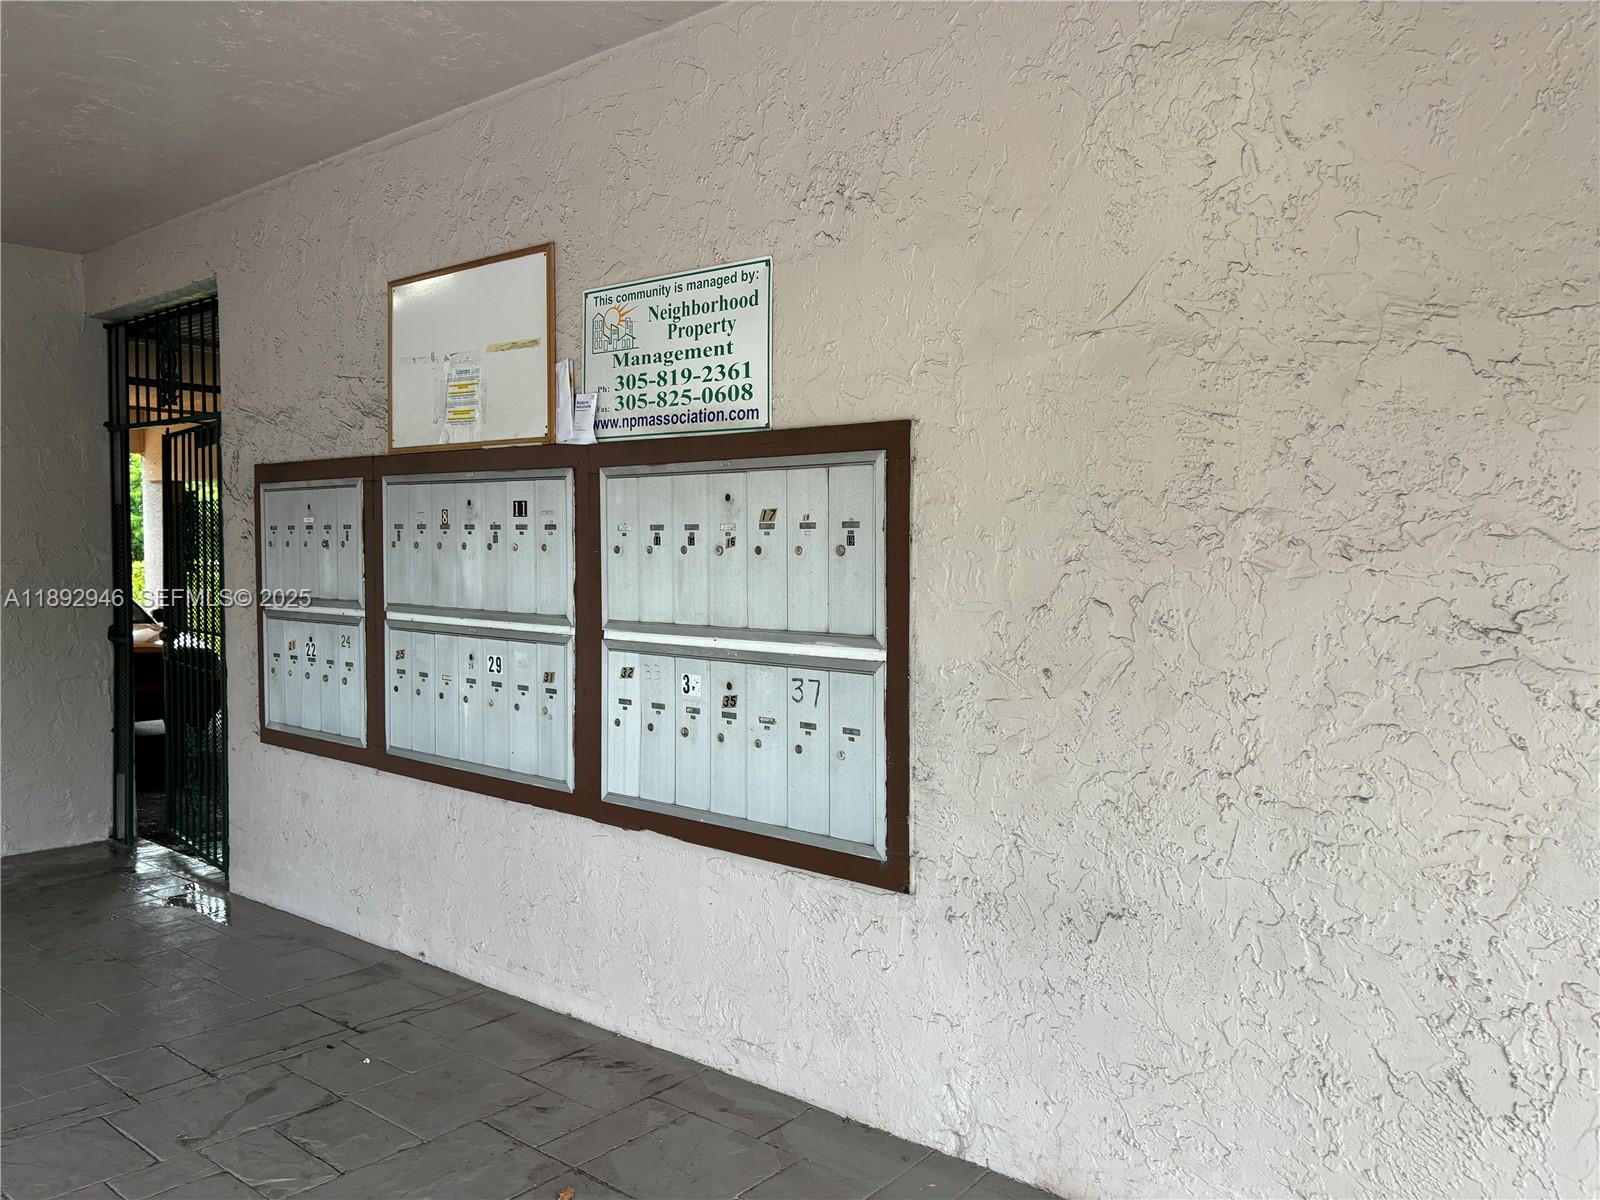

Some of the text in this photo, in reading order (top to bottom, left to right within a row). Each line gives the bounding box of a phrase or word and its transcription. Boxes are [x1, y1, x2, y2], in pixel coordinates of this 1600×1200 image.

[593, 269, 760, 307] This community is managed by:
[648, 289, 759, 323] Neighborhood
[667, 318, 737, 341] Property
[612, 340, 734, 369] Management
[597, 361, 752, 393] Ph: 305-819-2361
[614, 383, 754, 412] 305-825-0608
[595, 407, 760, 431] www.npmassociation.com
[514, 501, 527, 516] 11
[761, 508, 777, 521] 17
[442, 510, 448, 524] 8
[341, 635, 351, 648] 24
[306, 643, 316, 657] 22
[396, 650, 405, 659] 25
[488, 656, 502, 673] 29
[621, 667, 634, 678] 32
[543, 672, 554, 683] 31
[791, 678, 821, 708] 37
[723, 695, 737, 708] 35
